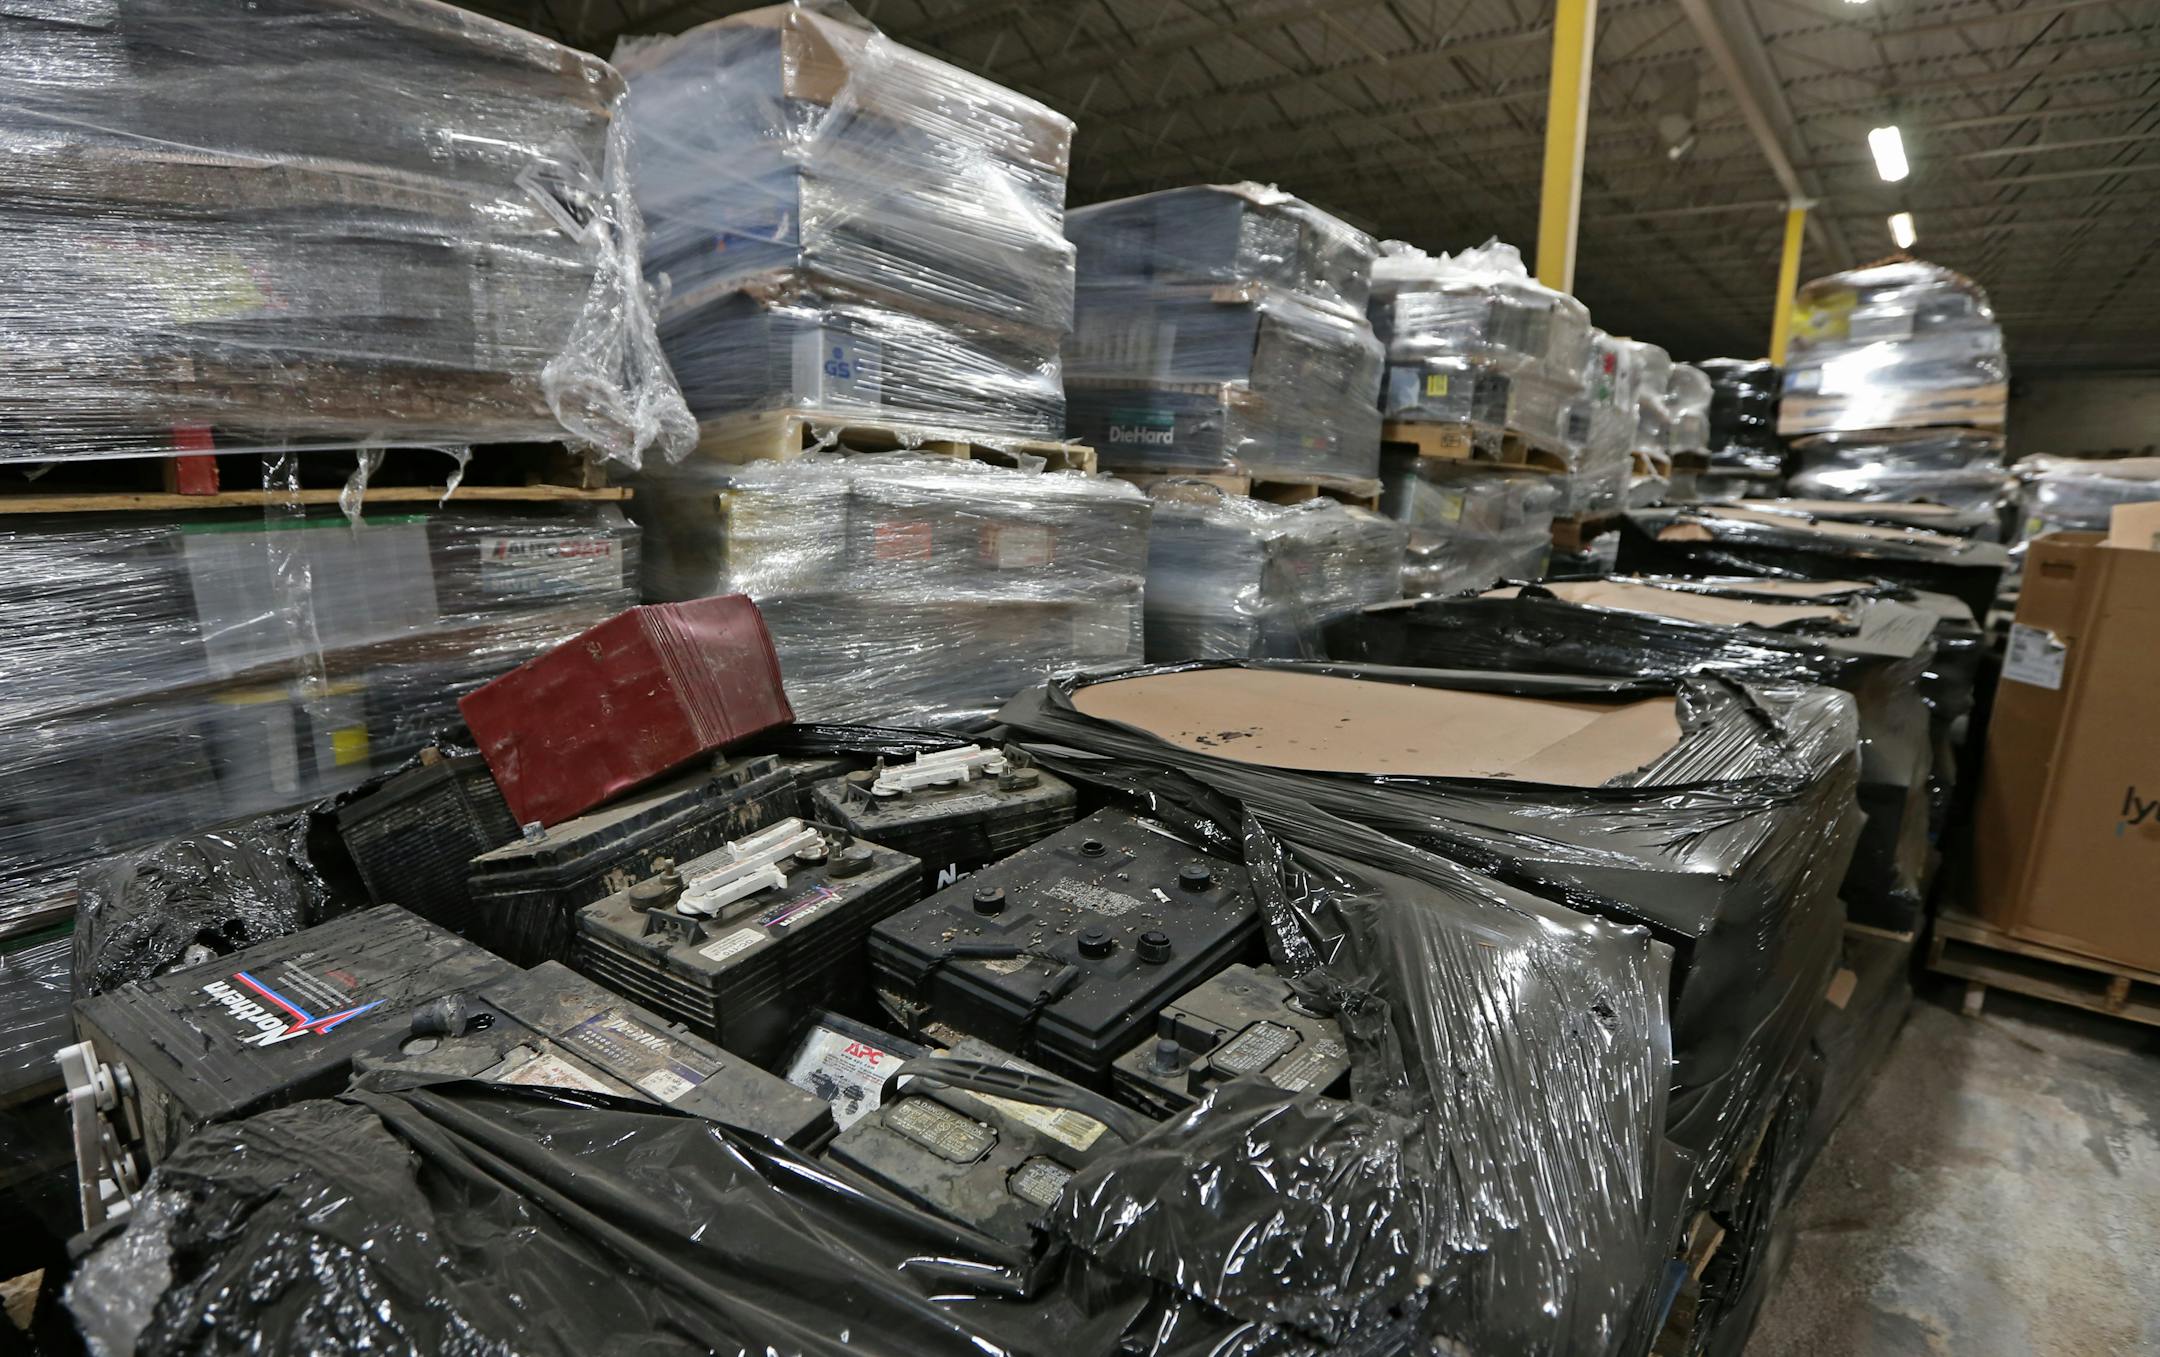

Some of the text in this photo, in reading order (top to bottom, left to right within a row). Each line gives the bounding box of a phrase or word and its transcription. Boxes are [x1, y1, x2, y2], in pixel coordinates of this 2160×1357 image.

[1109, 426, 1174, 445] DieHard
[2121, 786, 2160, 825] ly
[203, 980, 309, 1047] Northern
[843, 1041, 885, 1065] APC
